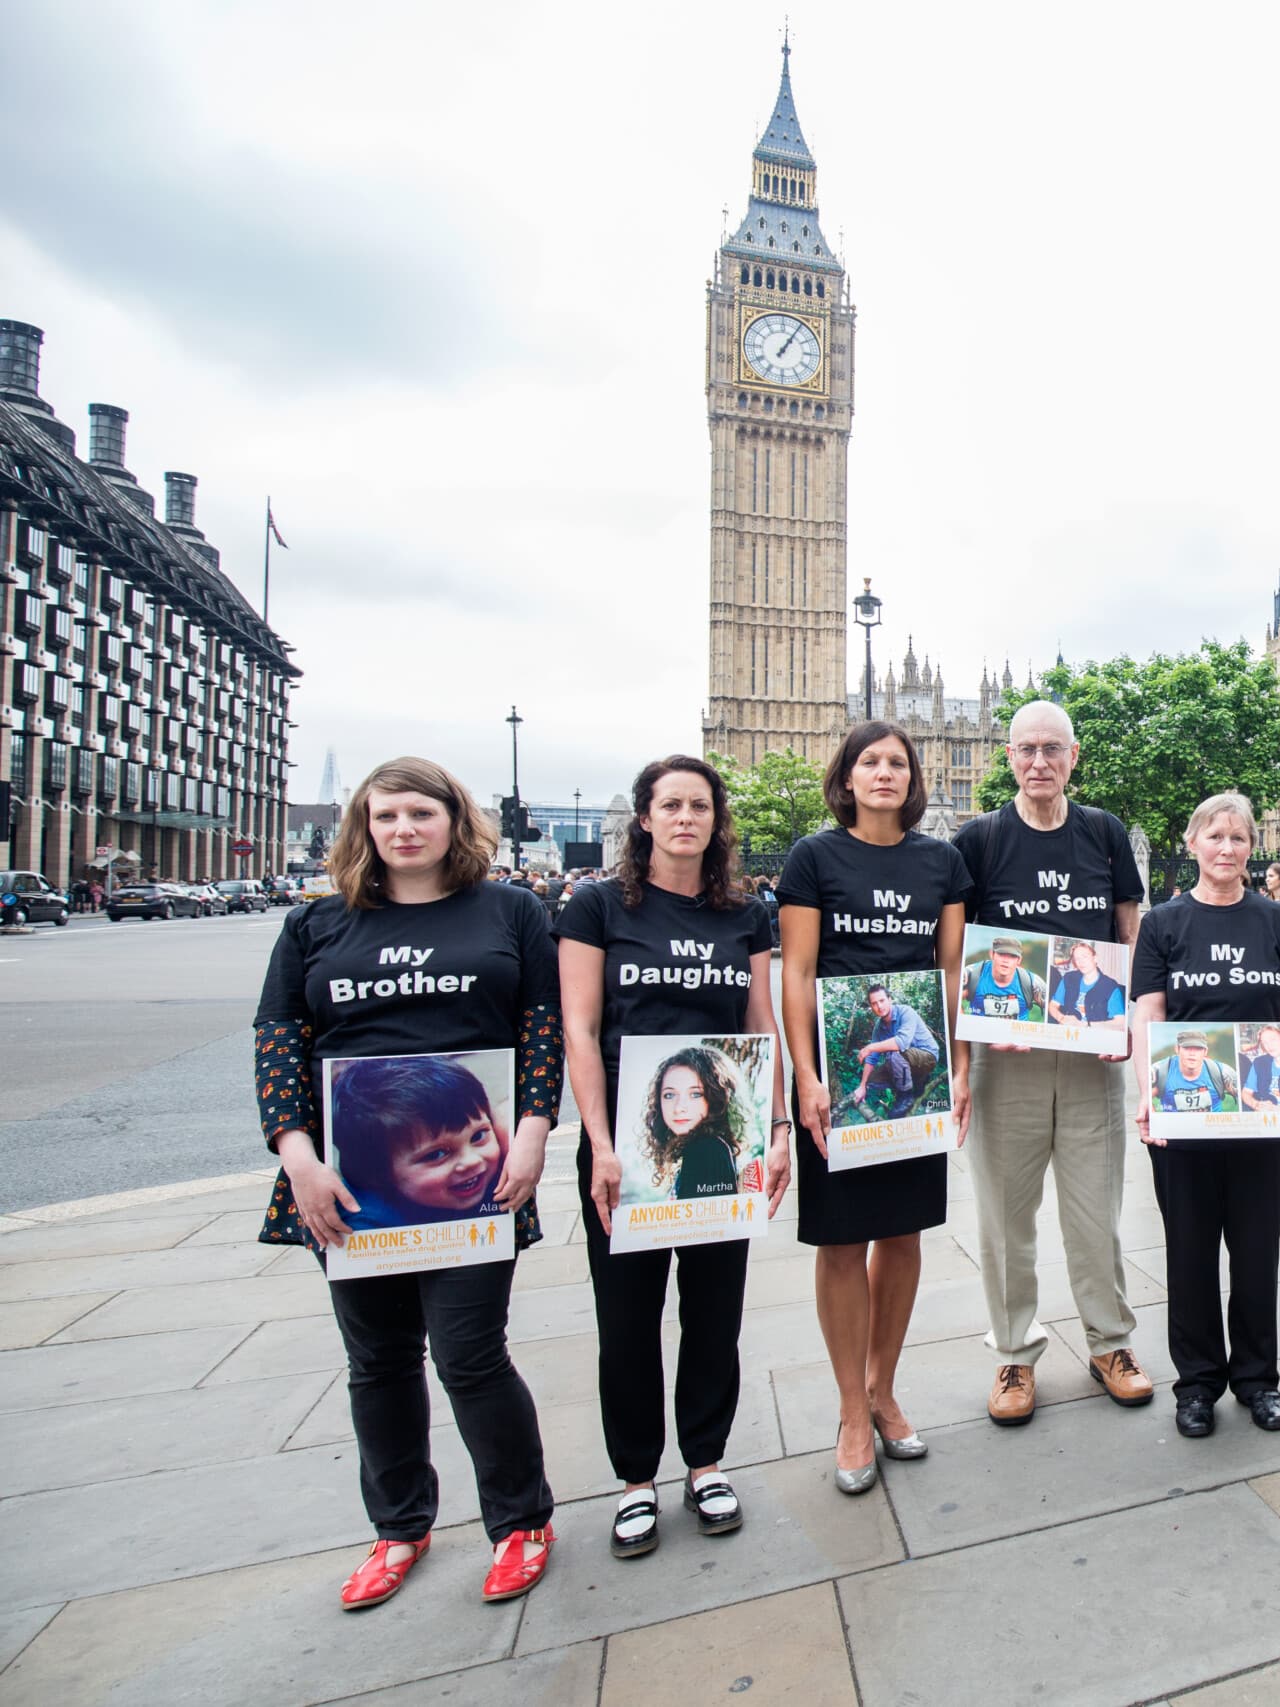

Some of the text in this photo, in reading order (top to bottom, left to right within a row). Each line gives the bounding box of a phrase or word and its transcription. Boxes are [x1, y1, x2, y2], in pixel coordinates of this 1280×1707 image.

[1037, 870, 1071, 891] My
[873, 889, 911, 913] My
[999, 894, 1107, 918] Two Sons
[378, 946, 434, 967] My
[670, 939, 715, 960] My
[1210, 944, 1245, 964] My
[329, 970, 478, 1004] Brother
[1171, 971, 1221, 990] Two
[994, 1002, 1009, 1015] 97
[1185, 1095, 1200, 1107] 97
[841, 1123, 894, 1145] ANYONE'S
[696, 1182, 733, 1193] Martha
[479, 1203, 499, 1213] Ala
[630, 1200, 729, 1224] ANYONE'S CHILD
[347, 1224, 465, 1251] ANYONE'S CHILD
